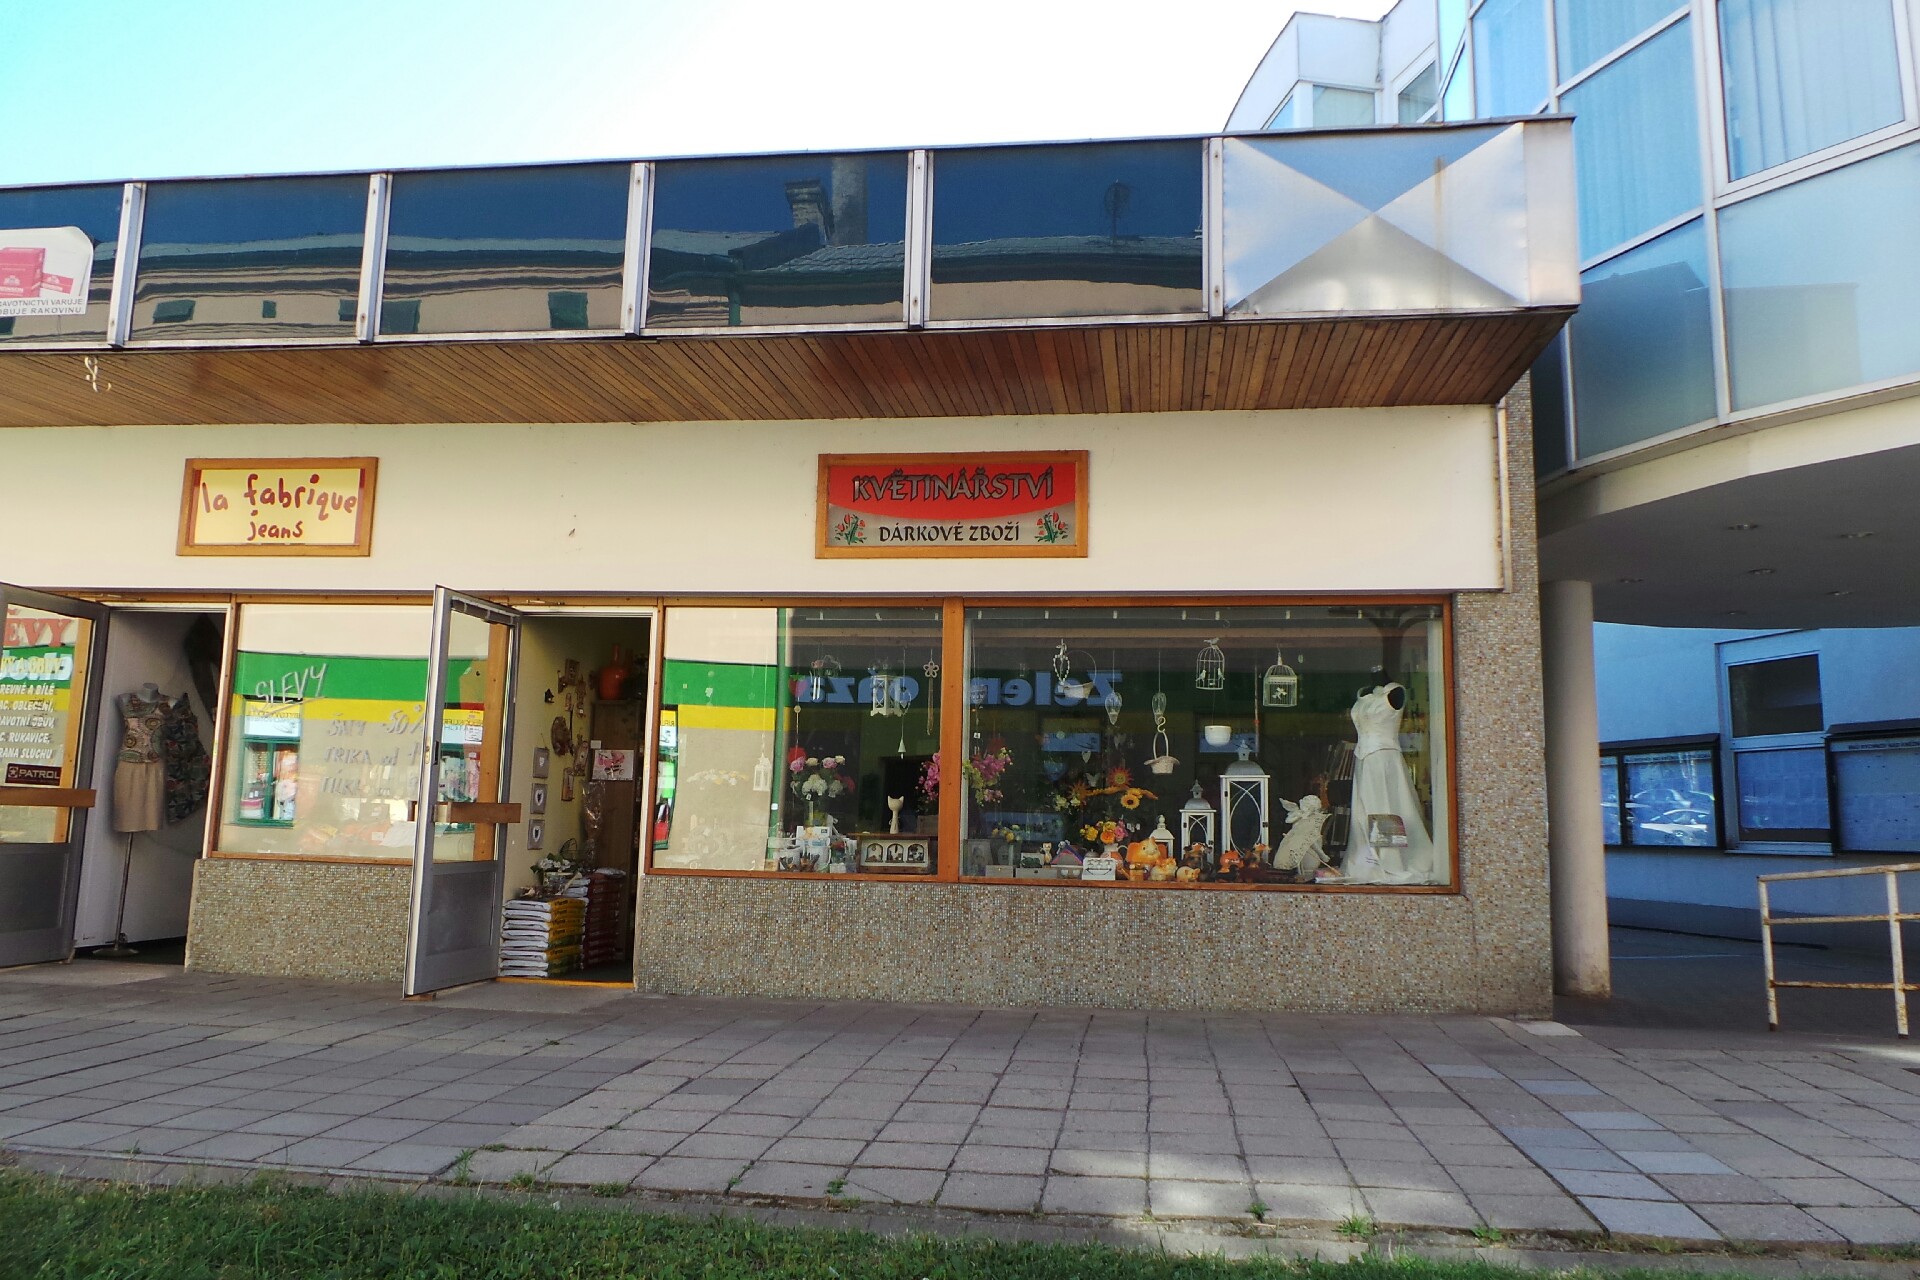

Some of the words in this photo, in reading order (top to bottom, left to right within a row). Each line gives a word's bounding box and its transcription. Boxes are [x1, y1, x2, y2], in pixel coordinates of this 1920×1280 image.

[51, 298, 83, 306] VARUJE
[30, 307, 82, 315] RAKOVINU
[852, 466, 1054, 502] KVĚTINÁŘSTVÍ
[203, 482, 228, 513] la
[244, 473, 358, 521] fabrique
[247, 509, 303, 541] jeans
[879, 522, 964, 543] DÁRKOVÉ
[969, 521, 1019, 542] ZBOŽÍ
[27, 684, 34, 695] A
[255, 663, 327, 709] SLEVY
[9, 731, 50, 745] RUKAVICE,
[20, 748, 53, 759] SLUCHU
[19, 769, 60, 779] PATROL
